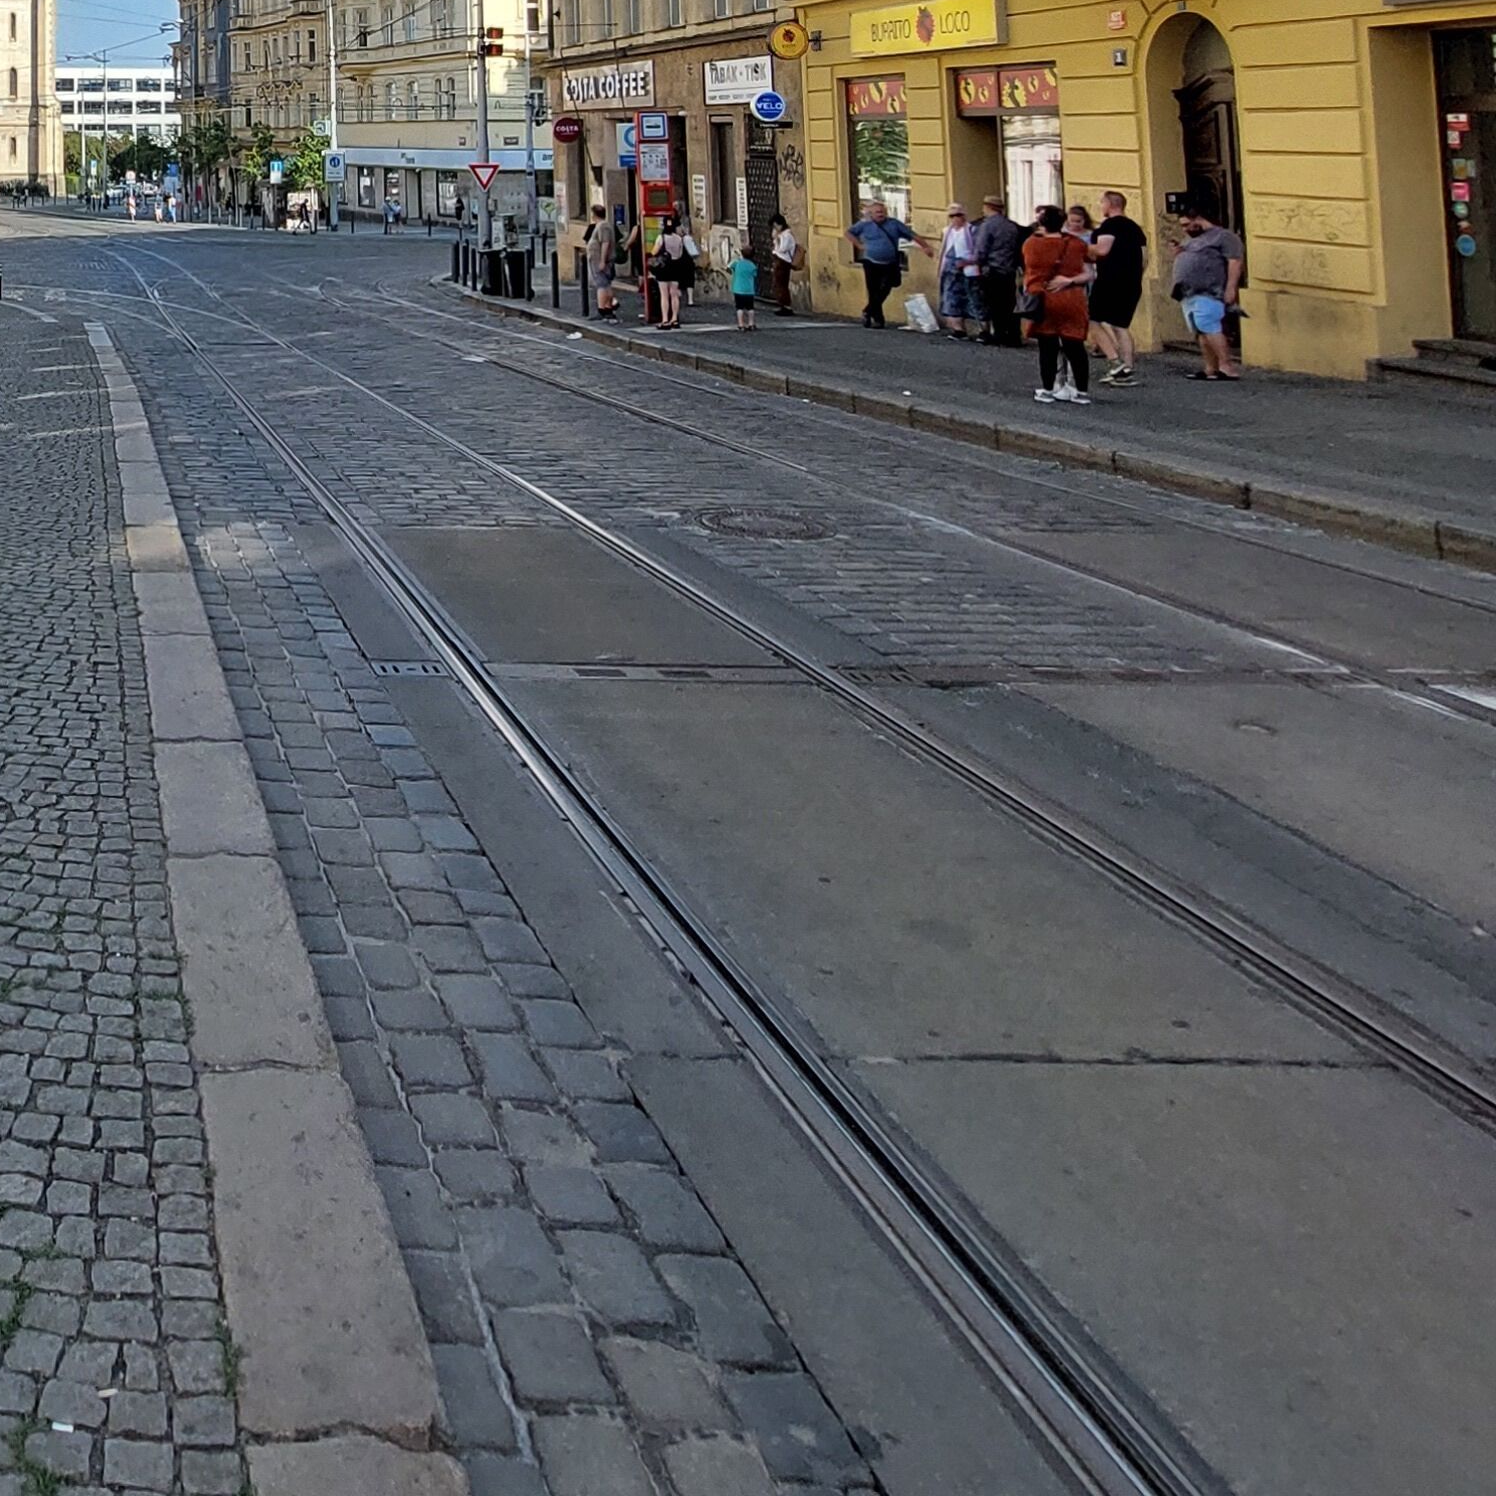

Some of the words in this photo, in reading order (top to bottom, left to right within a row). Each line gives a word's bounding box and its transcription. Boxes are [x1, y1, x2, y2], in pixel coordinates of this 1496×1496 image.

[871, 18, 911, 42] BURRITO
[939, 10, 971, 34] LOCO
[1115, 52, 1123, 63] 1
[709, 64, 738, 84] TABAK
[745, 62, 767, 82] TISK
[564, 75, 596, 103] COSTA
[598, 70, 646, 99] COFFEE
[756, 102, 784, 110] VELO
[555, 125, 579, 134] COSTA
